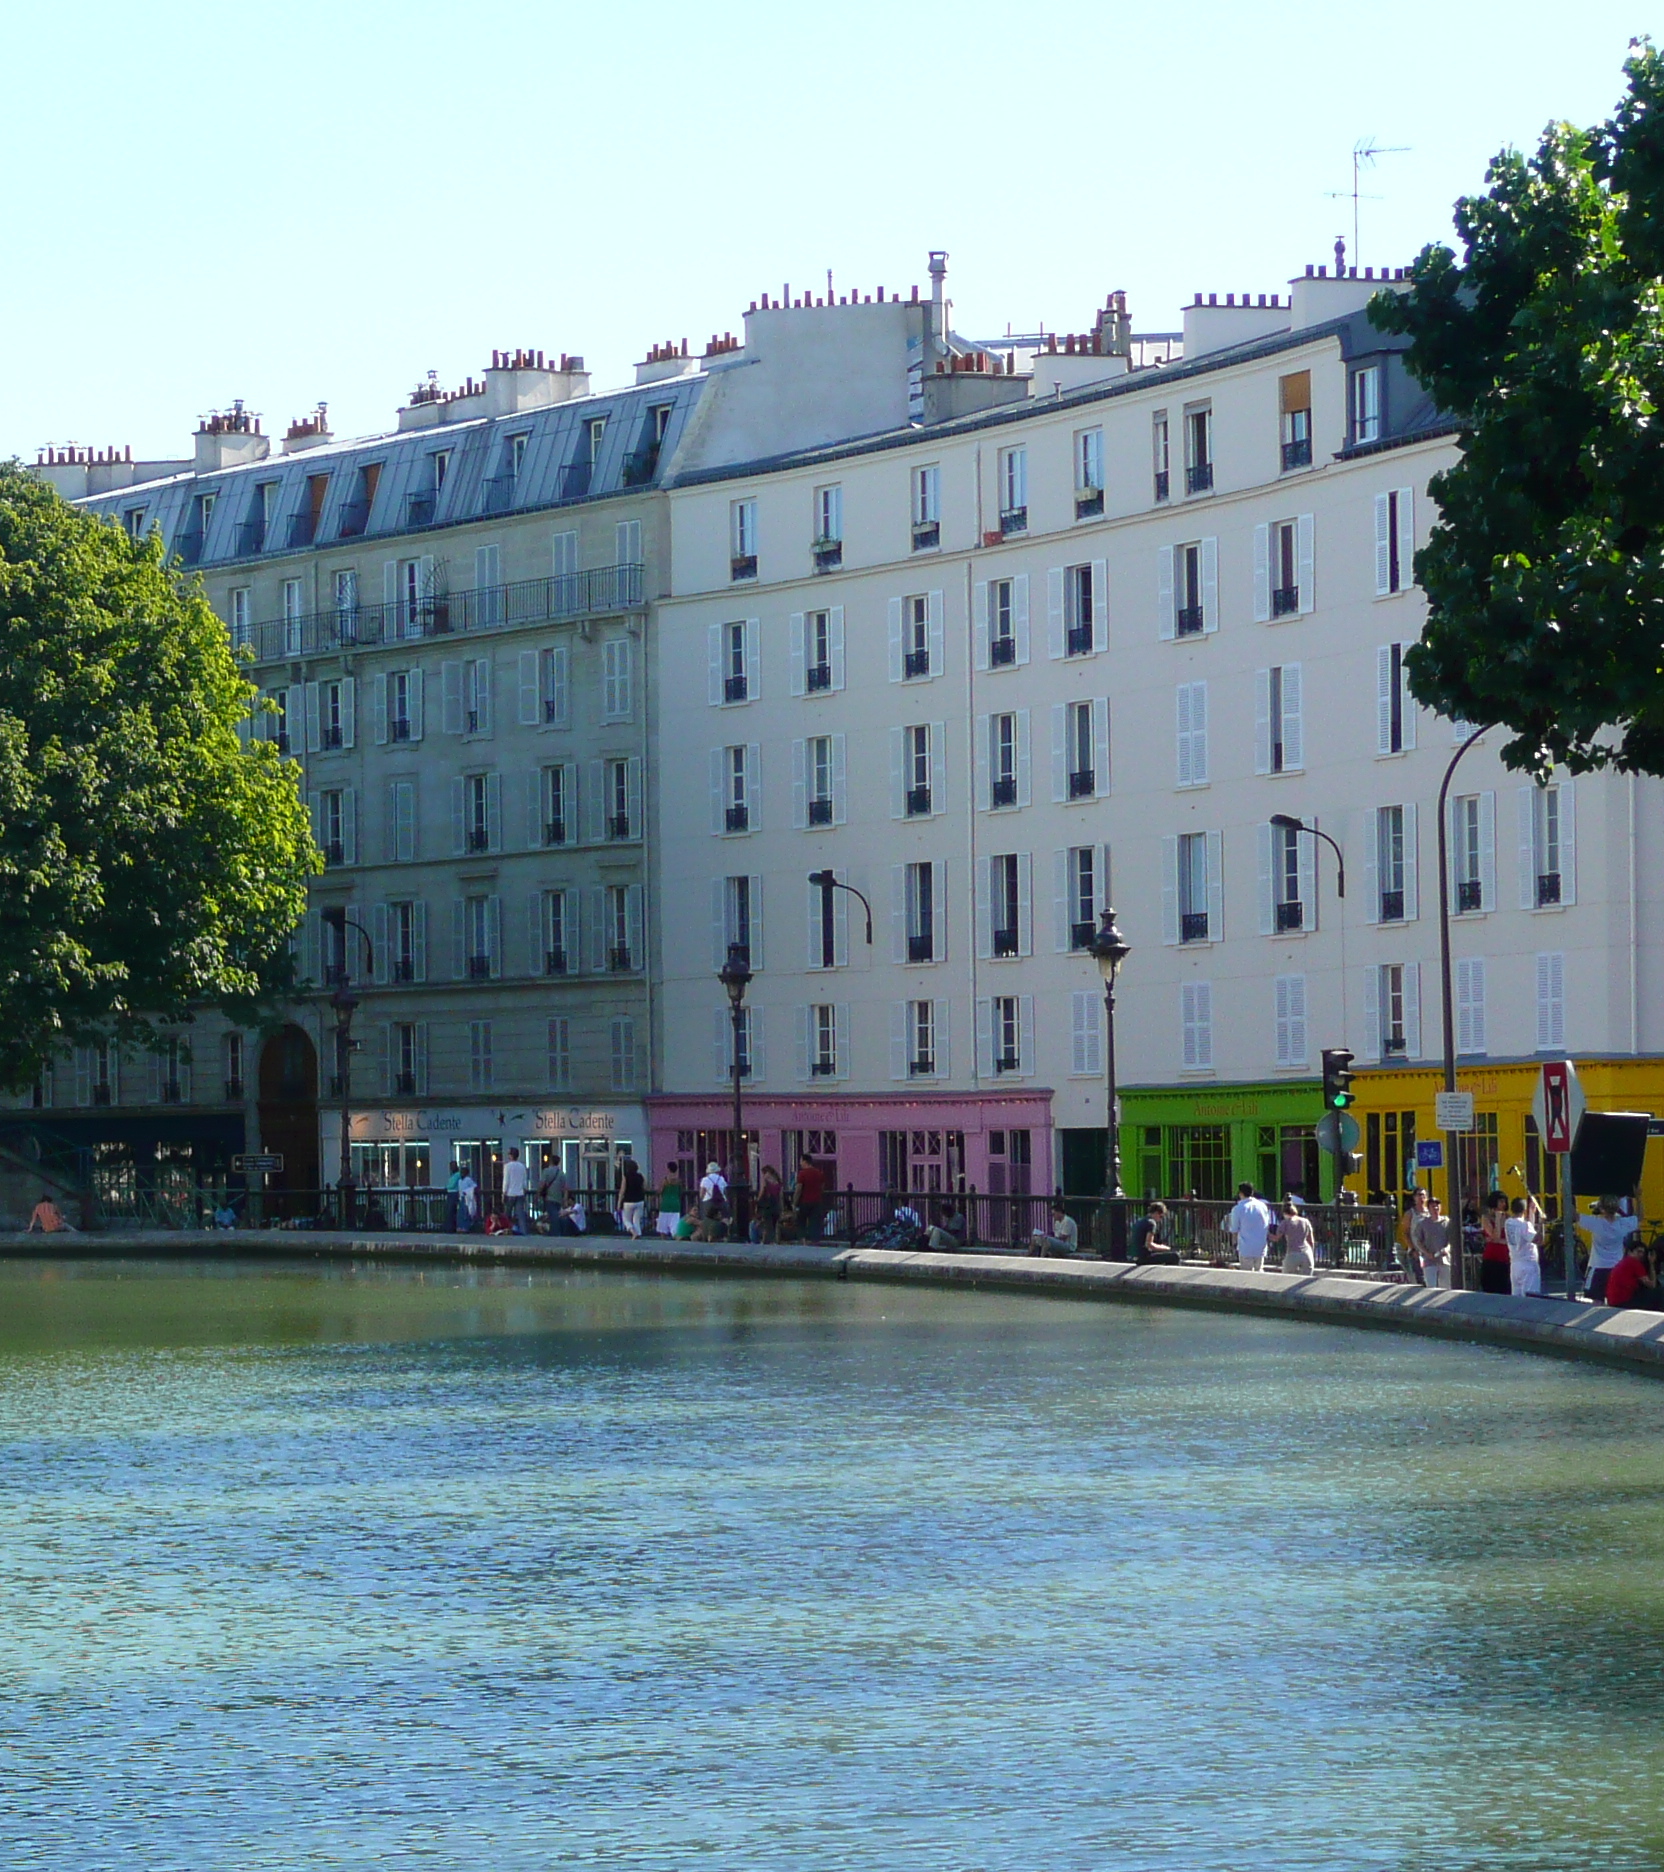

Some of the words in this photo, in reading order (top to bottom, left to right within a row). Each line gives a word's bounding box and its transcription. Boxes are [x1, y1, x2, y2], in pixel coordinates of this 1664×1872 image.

[532, 1107, 566, 1129] Stella
[568, 1107, 614, 1129] Cadente
[1193, 1100, 1229, 1117] Antoine
[1242, 1099, 1259, 1116] Lili
[382, 1110, 414, 1131] Stella
[417, 1110, 462, 1131] Cadente
